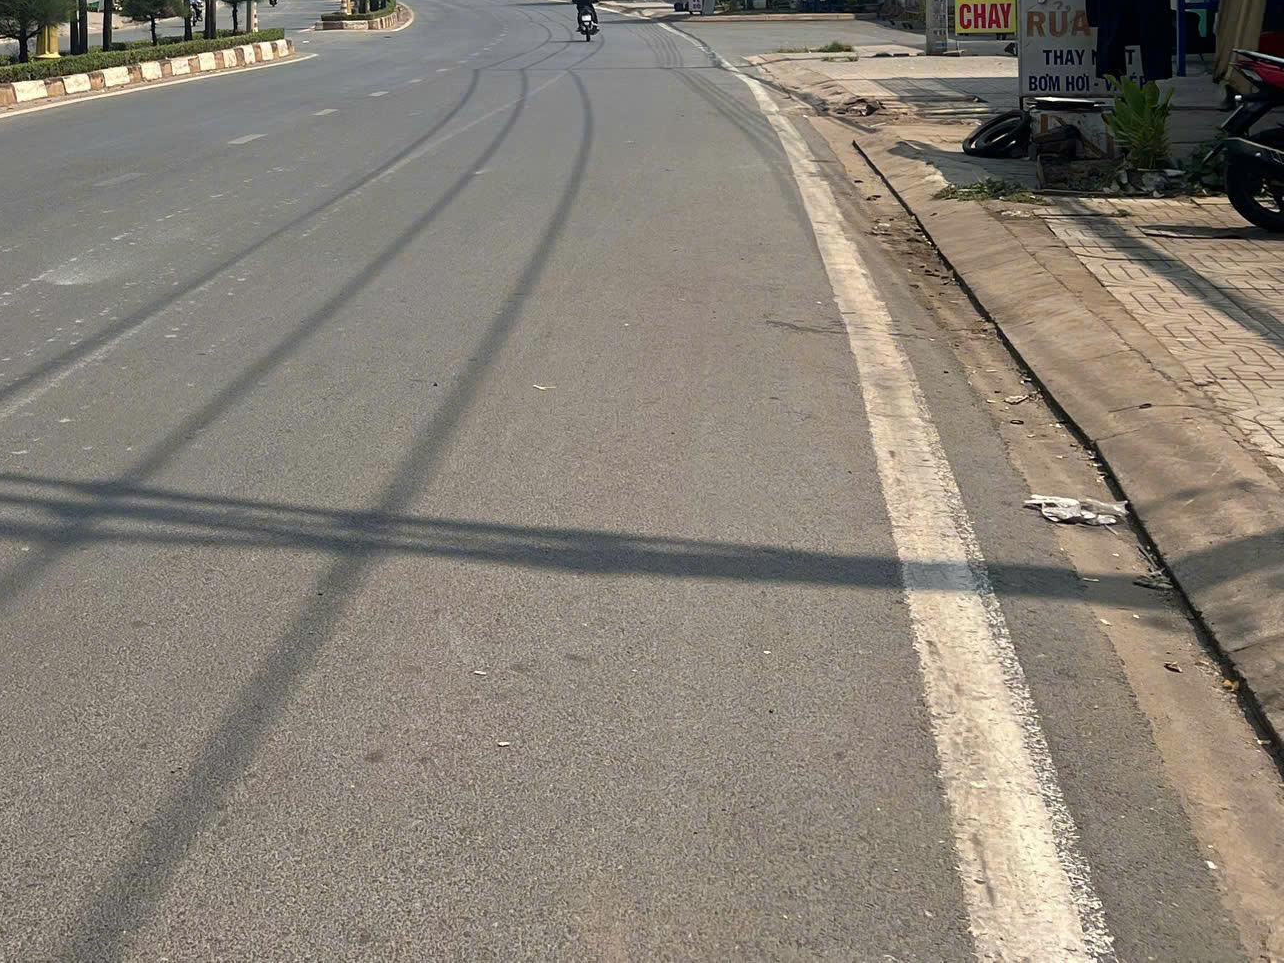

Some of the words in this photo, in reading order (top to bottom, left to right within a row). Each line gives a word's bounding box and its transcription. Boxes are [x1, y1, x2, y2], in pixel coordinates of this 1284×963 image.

[959, 3, 1012, 30] CHAY
[1043, 49, 1085, 66] THAY
[1028, 73, 1061, 92] BƠM
[1065, 73, 1091, 92] HƠI
